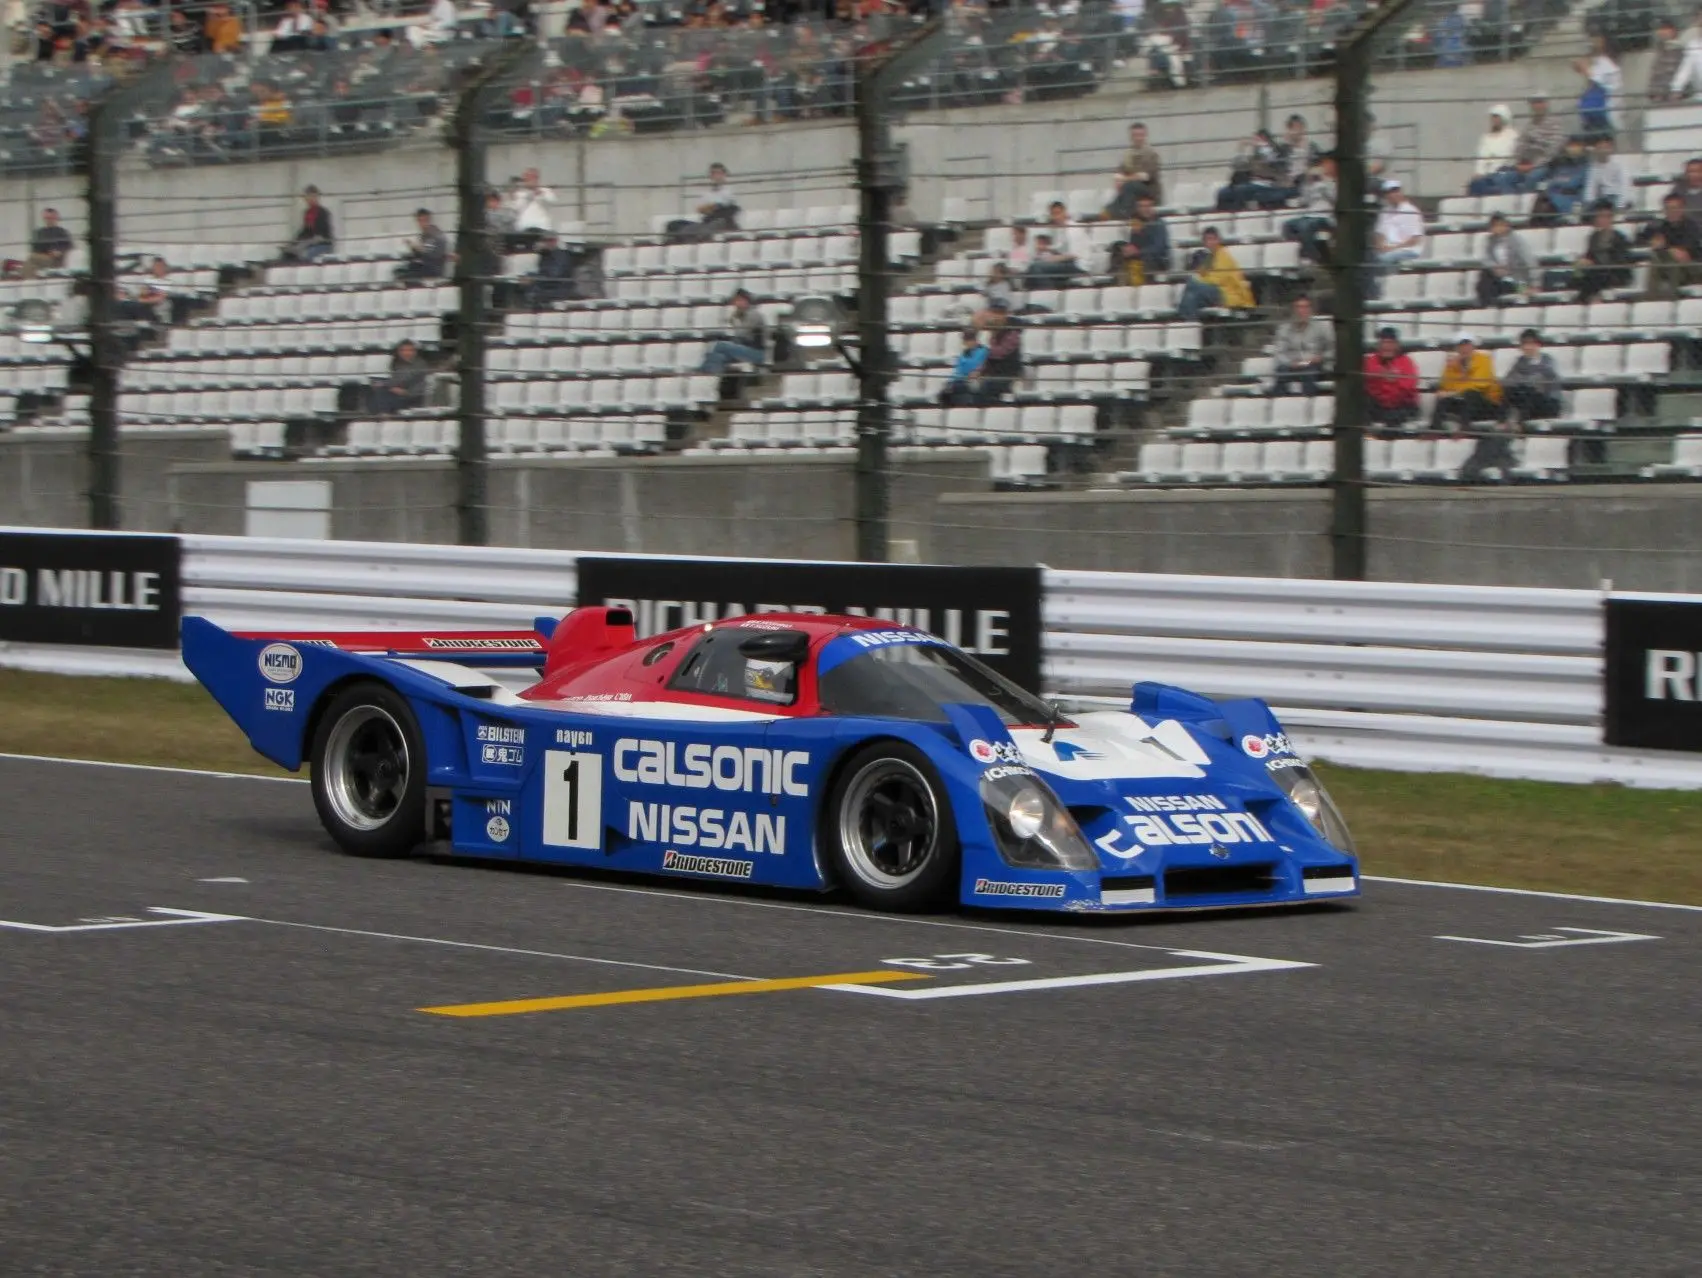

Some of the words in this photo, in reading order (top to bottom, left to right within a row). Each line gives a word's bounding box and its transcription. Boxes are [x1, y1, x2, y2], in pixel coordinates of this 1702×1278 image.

[37, 568, 160, 611] MILLE
[264, 653, 297, 669] NISMO
[266, 690, 293, 706] NGK
[487, 726, 525, 744] BILSTEIN
[564, 760, 579, 840] 1
[1123, 795, 1227, 812] NISSAN
[629, 801, 785, 855] NISSAN
[1094, 812, 1284, 859] CALSONI
[664, 851, 752, 877] BRIDGESTONE
[975, 879, 1064, 897] BRIDGESTONE
